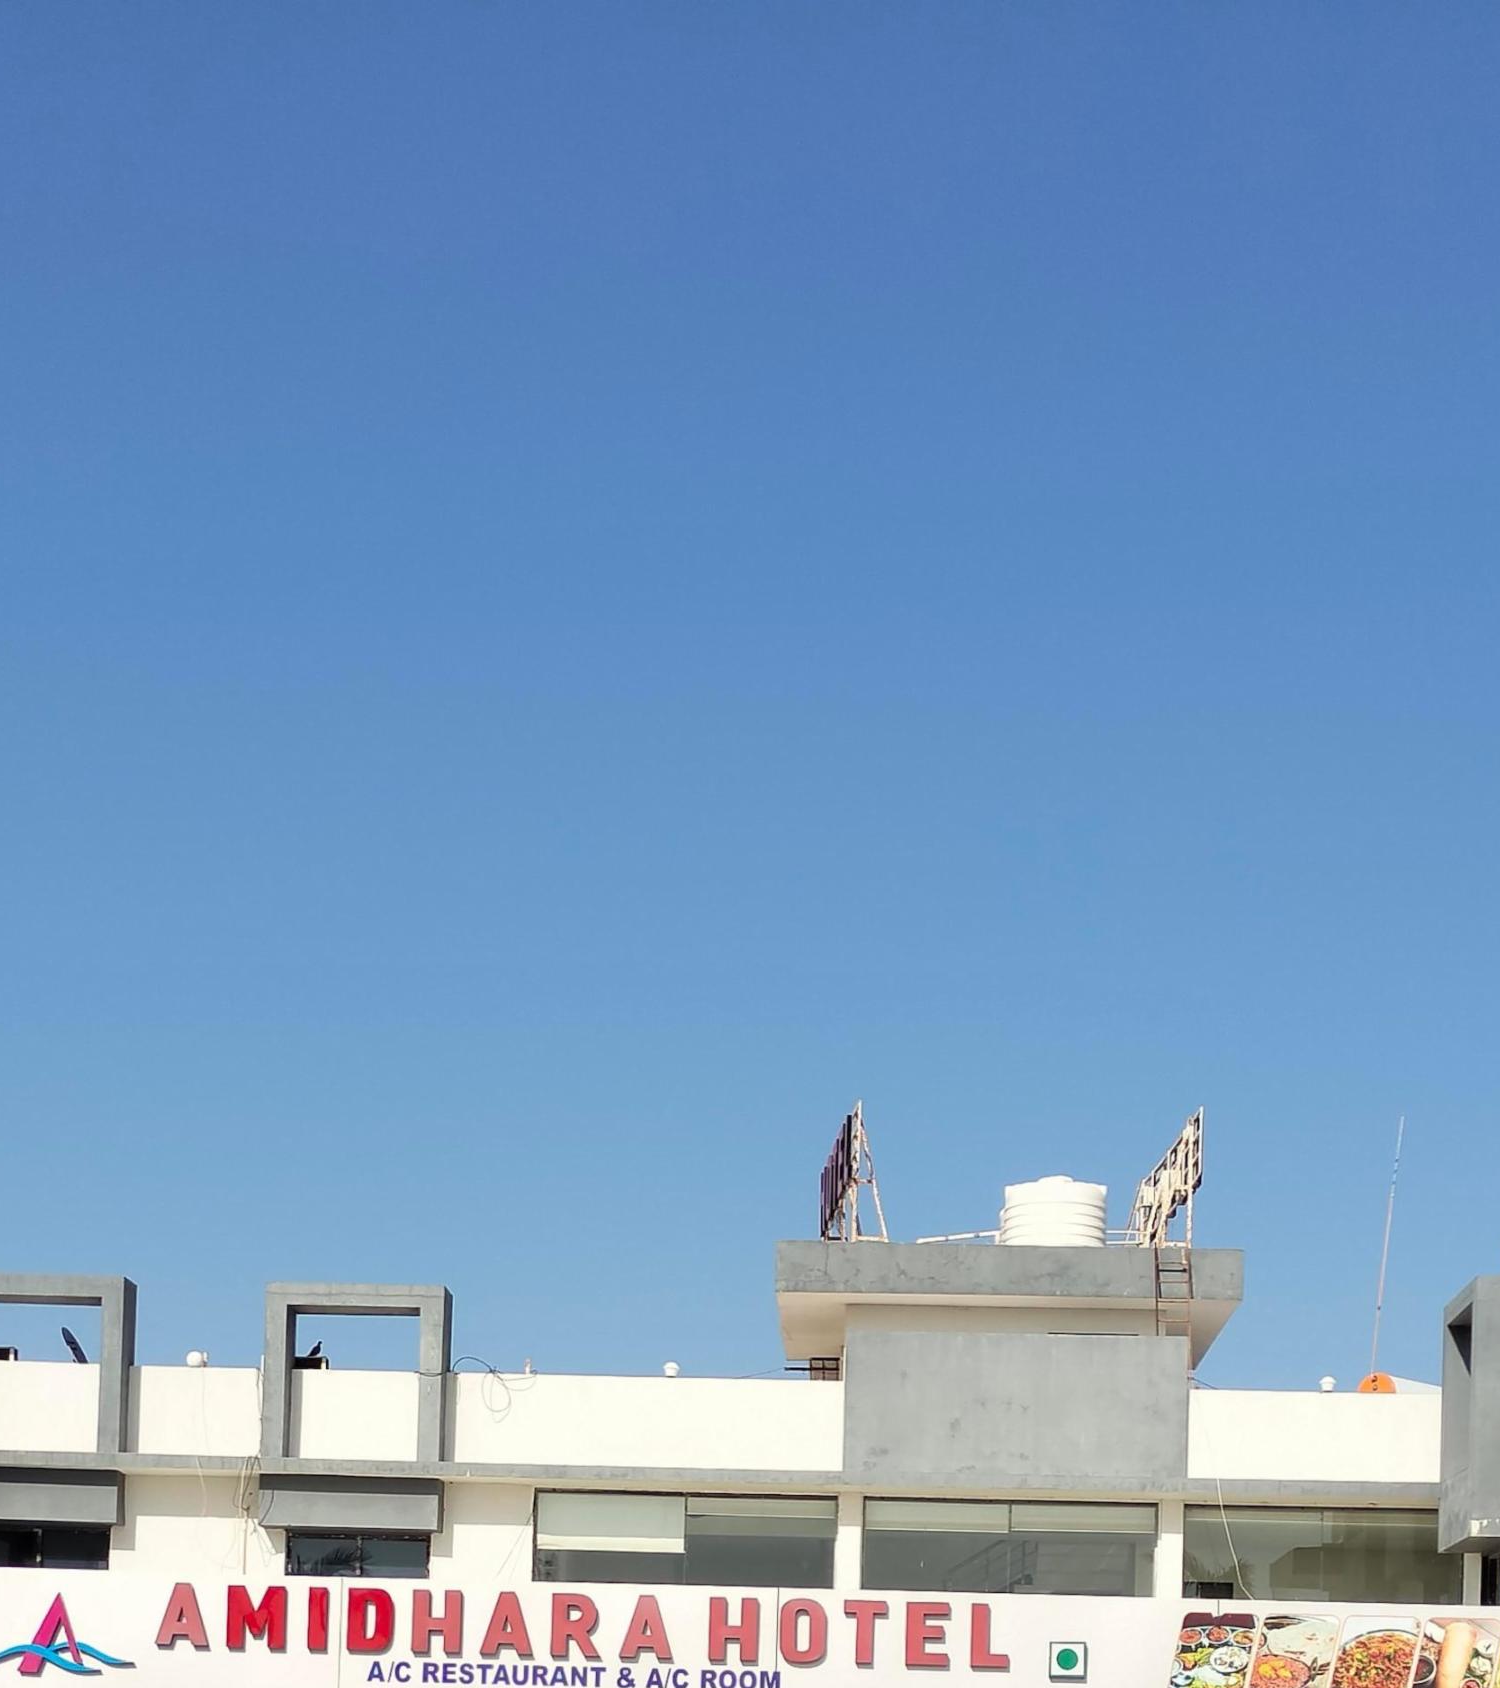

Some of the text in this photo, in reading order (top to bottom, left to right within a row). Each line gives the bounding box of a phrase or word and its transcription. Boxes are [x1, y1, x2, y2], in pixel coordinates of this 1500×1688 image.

[155, 1582, 1010, 1671] AMIDHARA HOTEL
[367, 1660, 412, 1683] A/C
[422, 1662, 607, 1688] RESTAURANT
[617, 1668, 638, 1688] &
